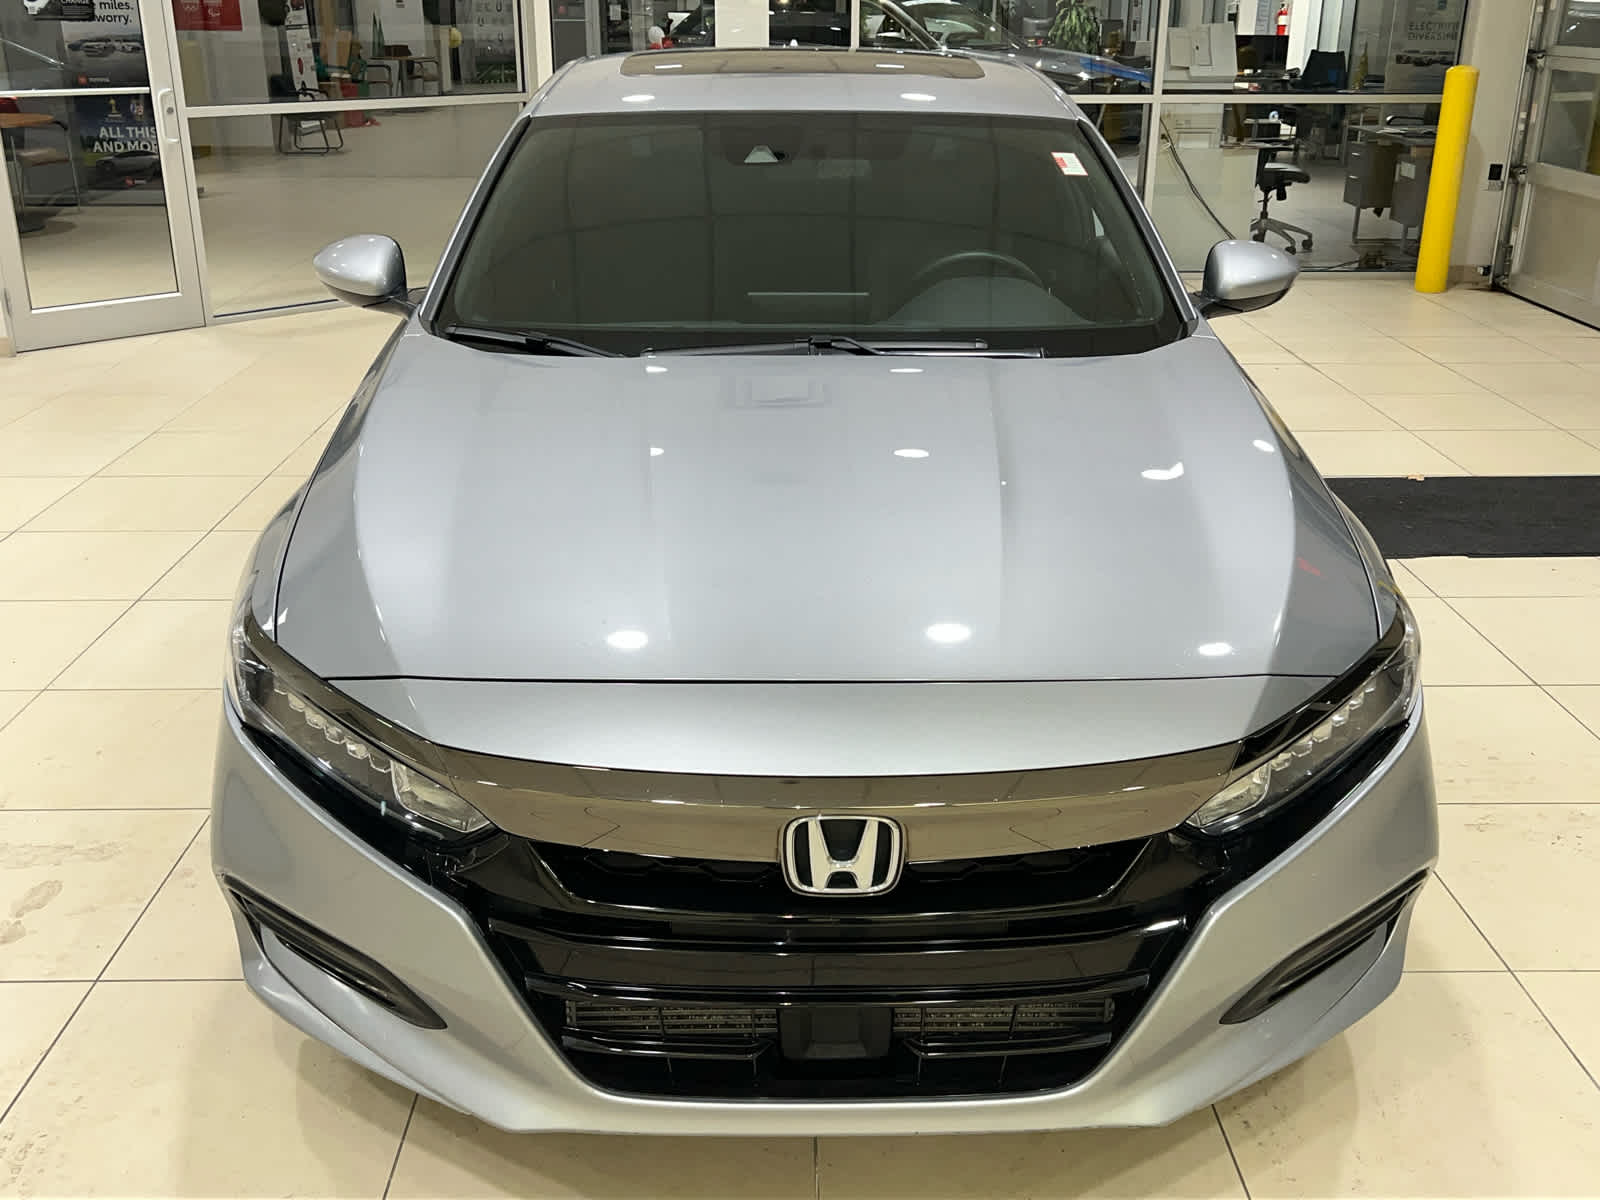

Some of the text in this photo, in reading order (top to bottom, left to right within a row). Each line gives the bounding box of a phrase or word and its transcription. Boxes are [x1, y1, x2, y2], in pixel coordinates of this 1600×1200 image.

[99, 0, 134, 10] miles.
[95, 14, 132, 25] worry.
[99, 126, 156, 138] ALL THIS
[93, 141, 124, 153] AND
